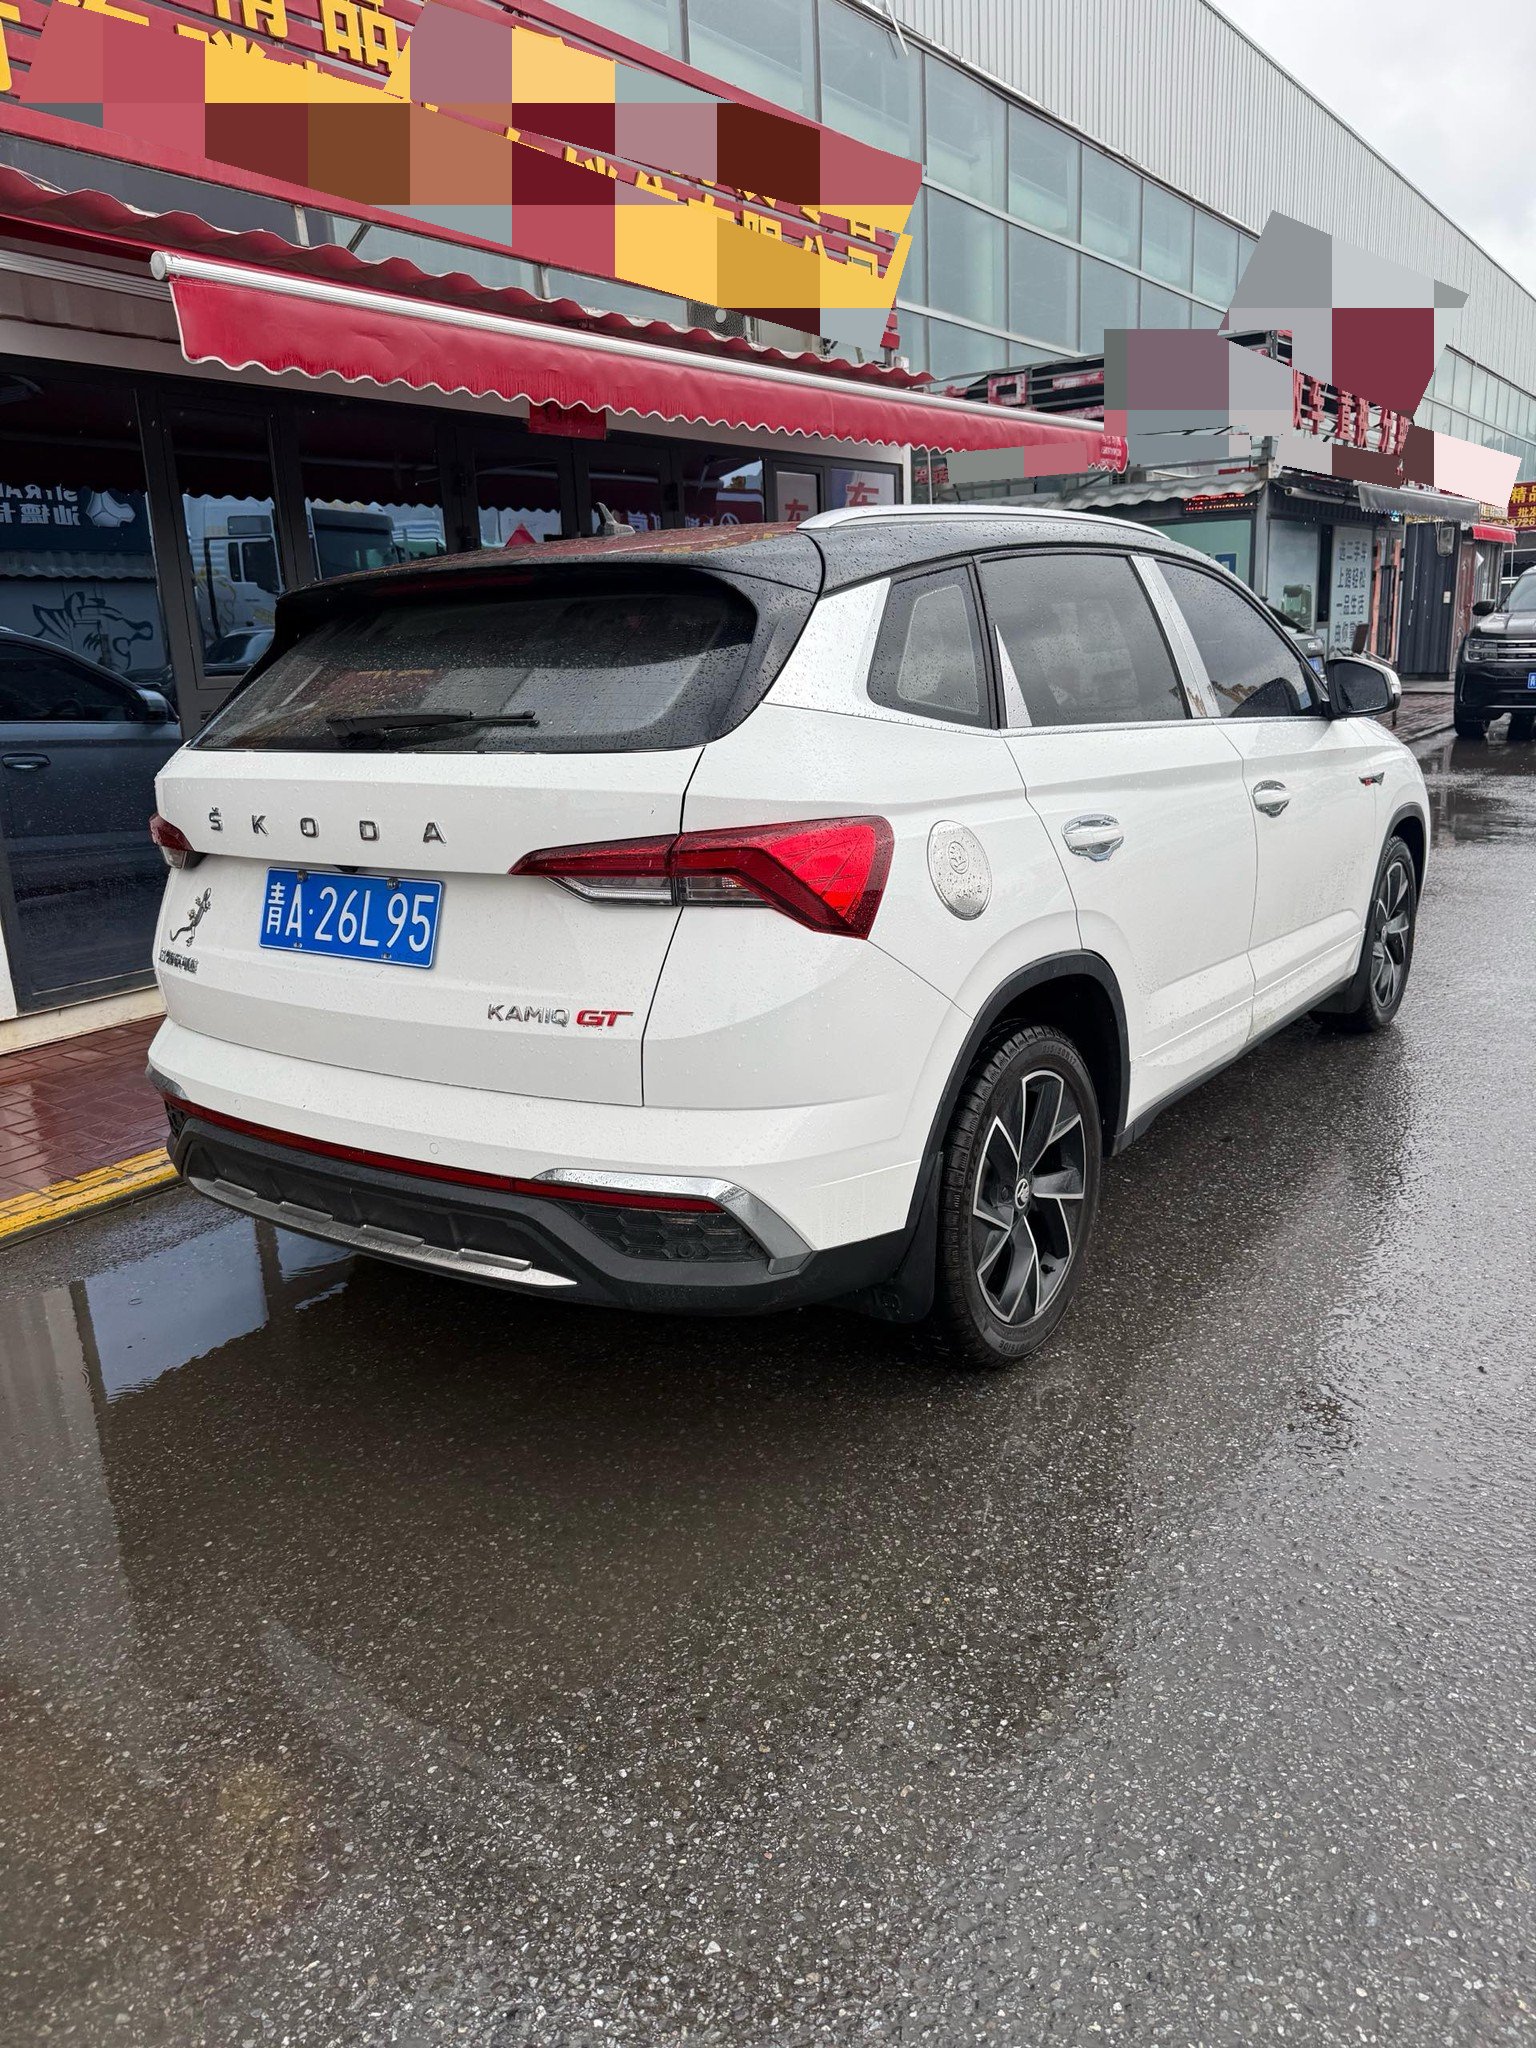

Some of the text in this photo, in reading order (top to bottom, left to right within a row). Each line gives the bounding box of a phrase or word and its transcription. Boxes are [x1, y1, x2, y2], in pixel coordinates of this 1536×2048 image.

[208, 806, 448, 844] ŠKODA
[488, 1004, 635, 1028] KAMIQ GT
